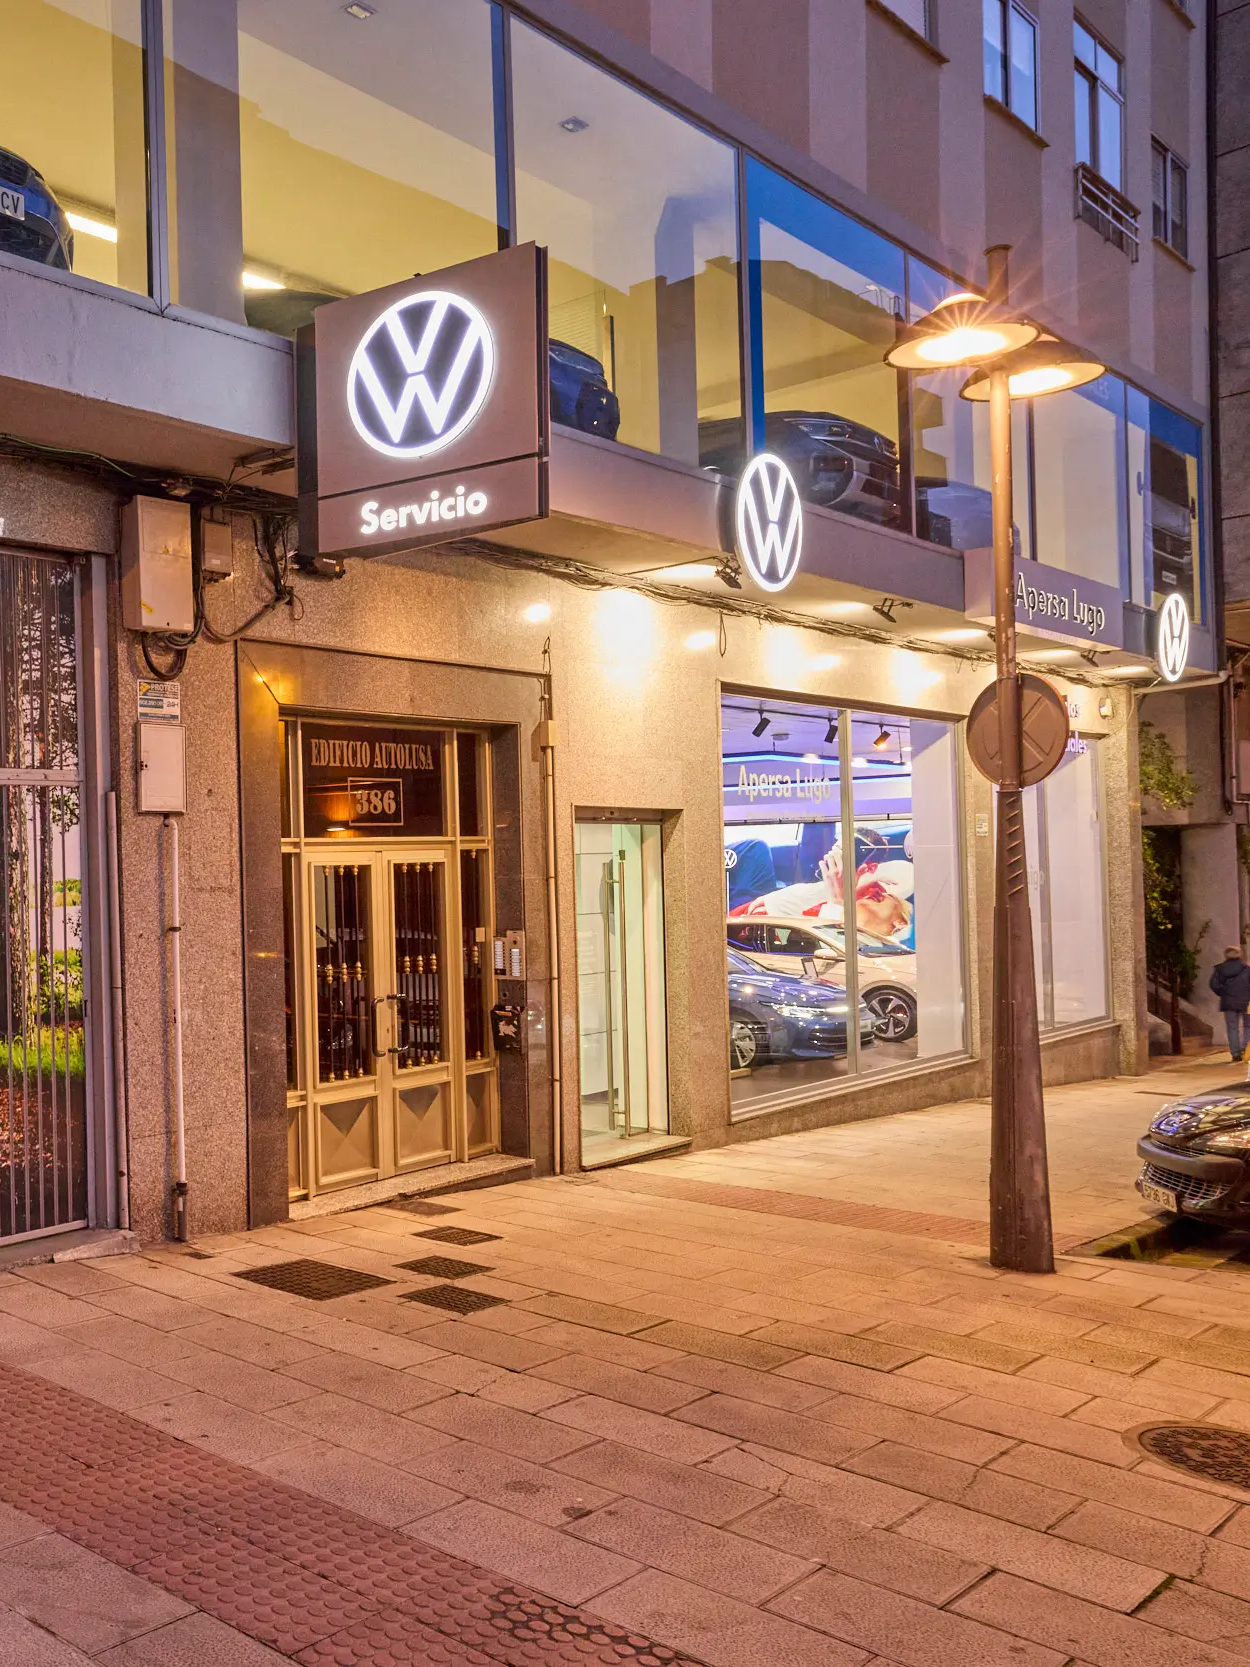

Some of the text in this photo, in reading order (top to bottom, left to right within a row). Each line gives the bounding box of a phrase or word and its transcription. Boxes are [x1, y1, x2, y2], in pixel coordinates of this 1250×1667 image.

[359, 485, 488, 536] Servicio
[1015, 571, 1105, 636] Apersa Lugo
[310, 738, 434, 770] EDIFICIO AUTOLUSA
[355, 789, 397, 815] 386
[737, 764, 831, 804] Apersa Lugo
